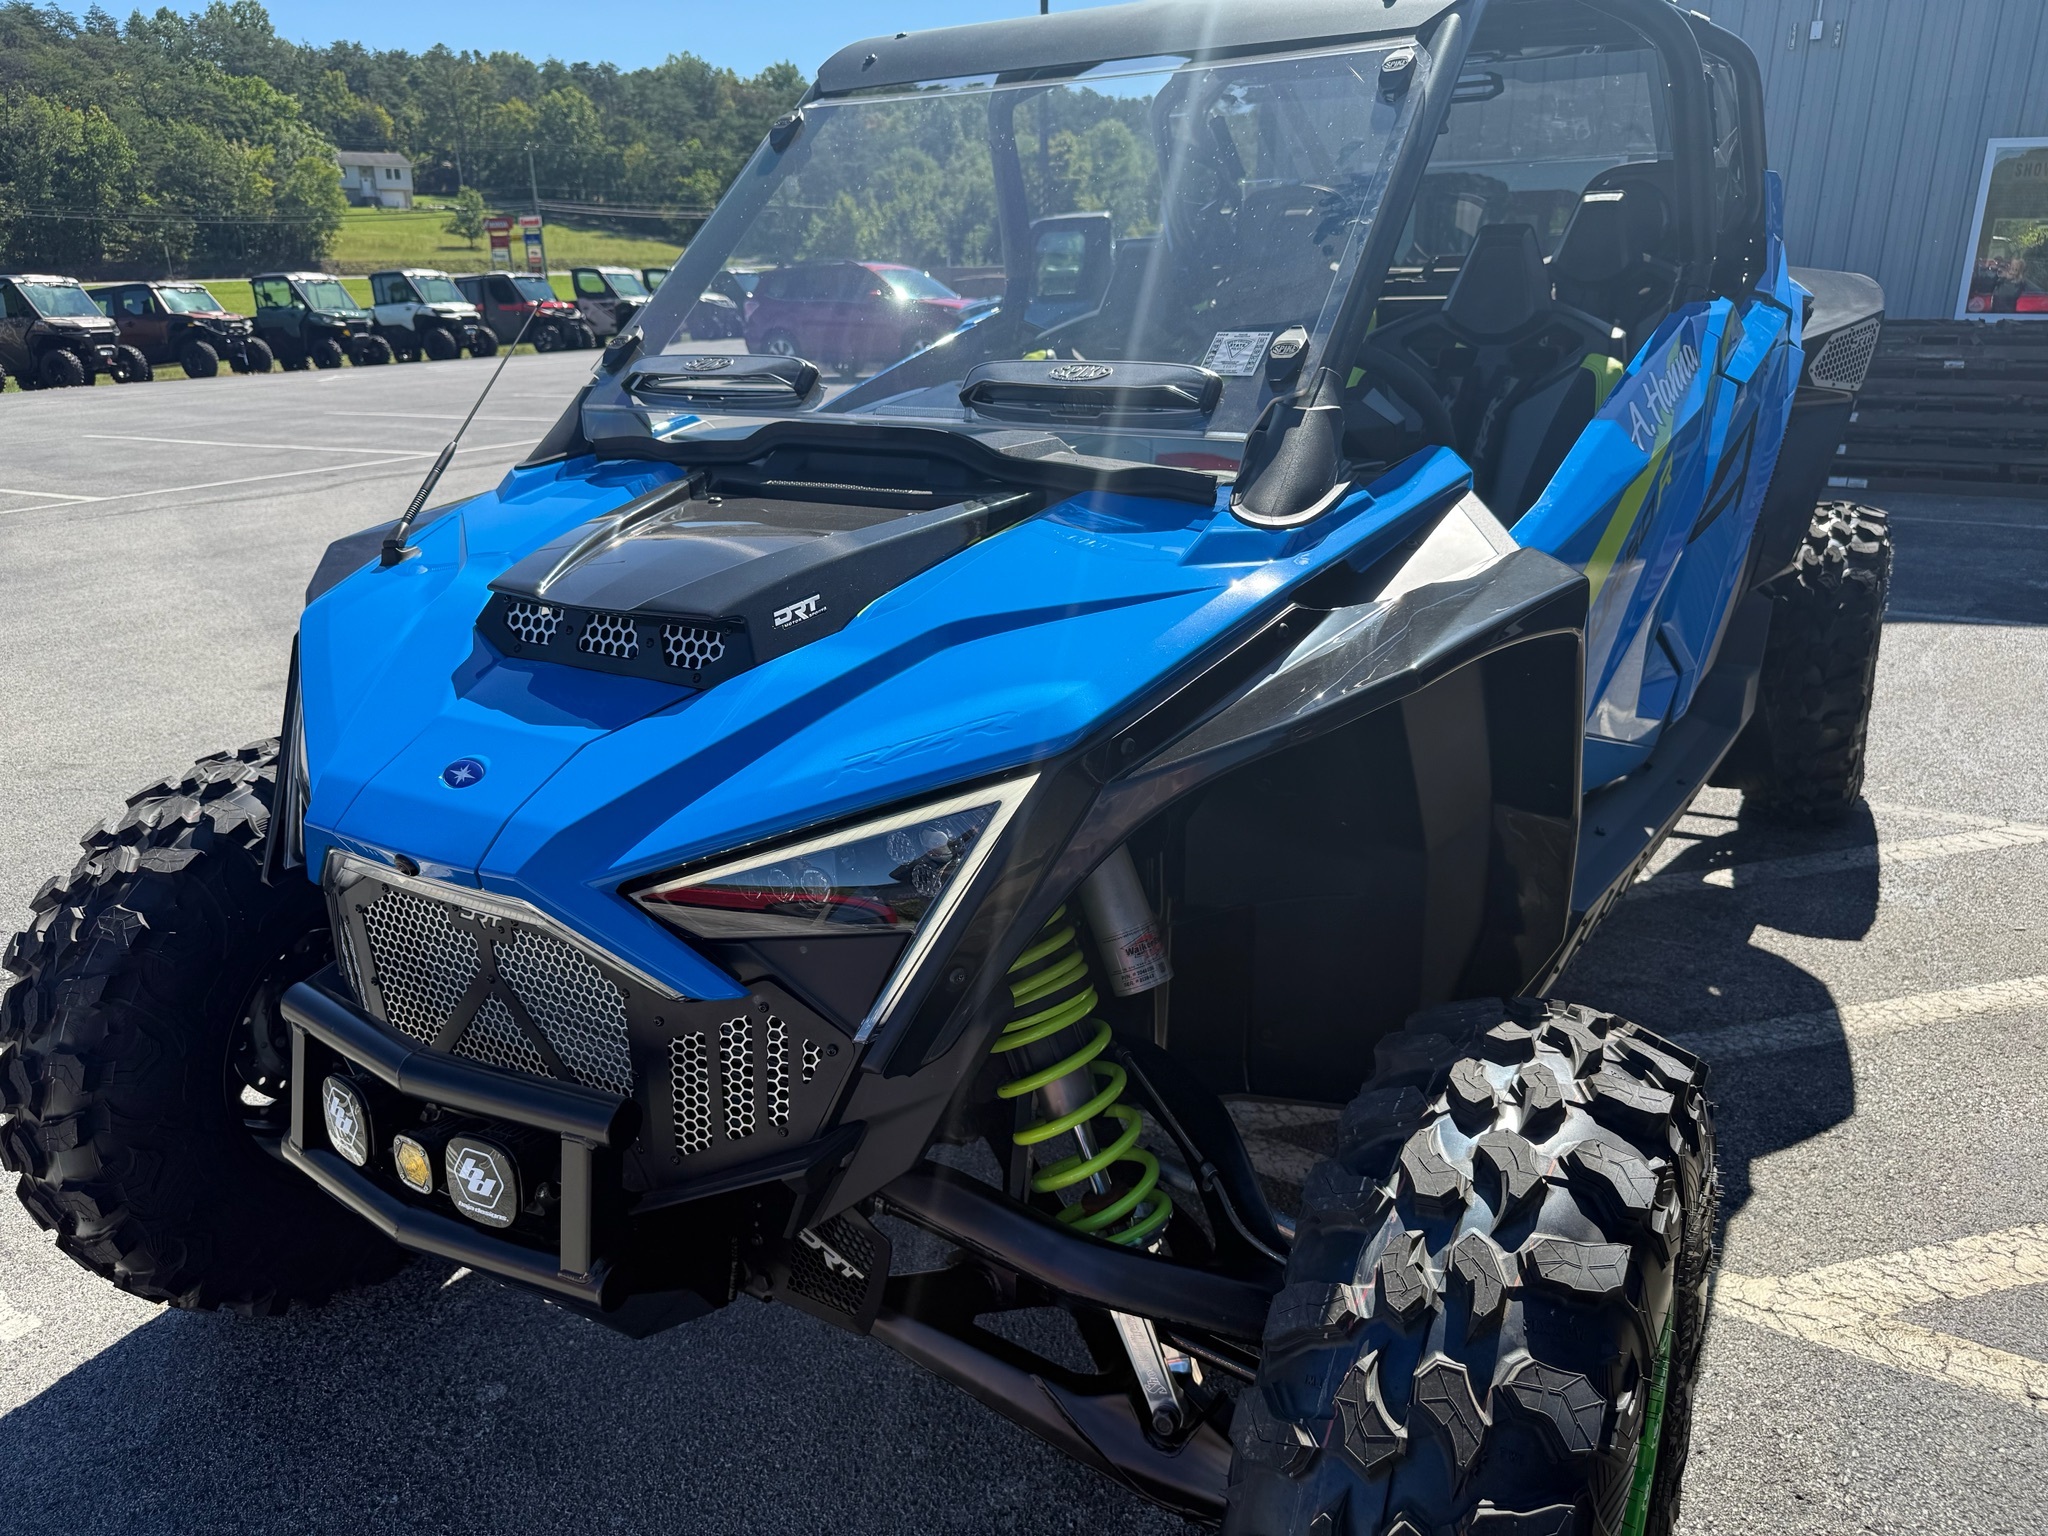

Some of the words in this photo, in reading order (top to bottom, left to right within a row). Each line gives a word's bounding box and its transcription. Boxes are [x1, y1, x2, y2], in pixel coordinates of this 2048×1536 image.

[1272, 343, 1299, 355] SPIKE
[1049, 364, 1113, 380] SPIKE
[1641, 343, 1699, 425] Hanna
[773, 593, 820, 627] DRT
[460, 906, 502, 929] DRT
[799, 1227, 865, 1279] DRT
